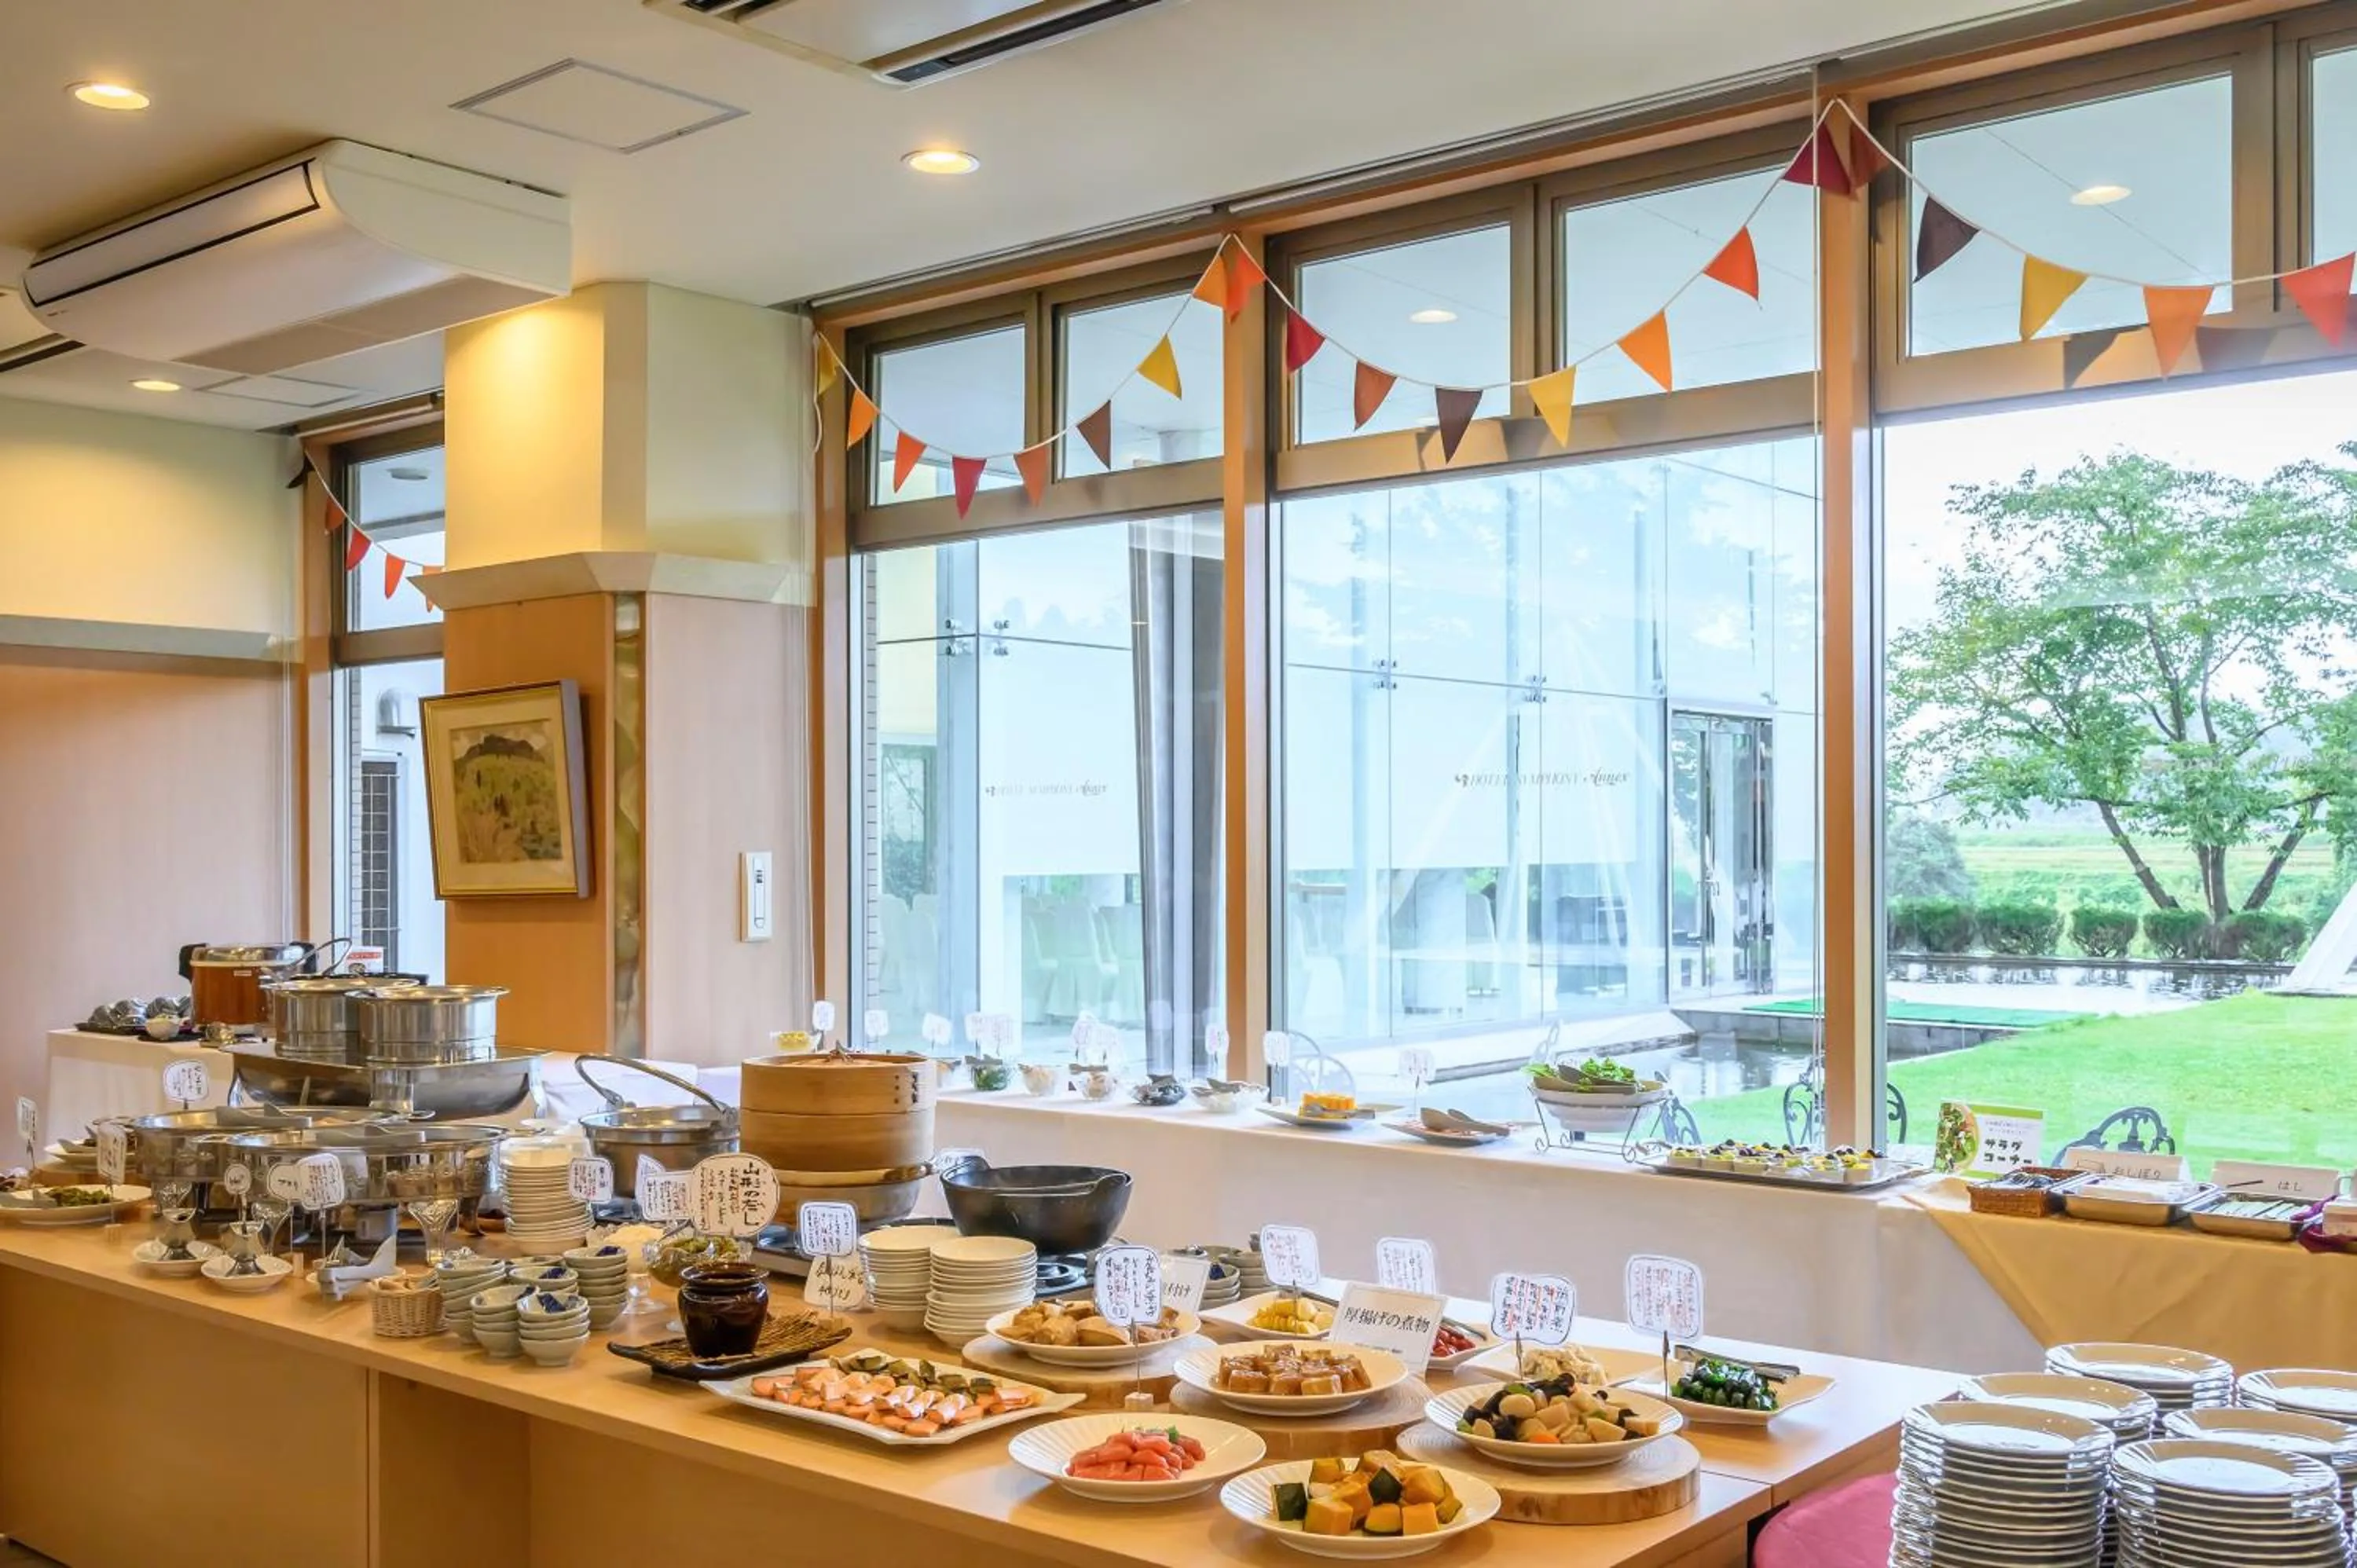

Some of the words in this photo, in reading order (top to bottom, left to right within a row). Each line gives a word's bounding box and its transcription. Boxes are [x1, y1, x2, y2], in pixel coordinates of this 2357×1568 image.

[1985, 1152, 2032, 1164] コーナー
[2278, 1181, 2302, 1192] はし
[1344, 1306, 1431, 1333] 厚揚げの煮物
